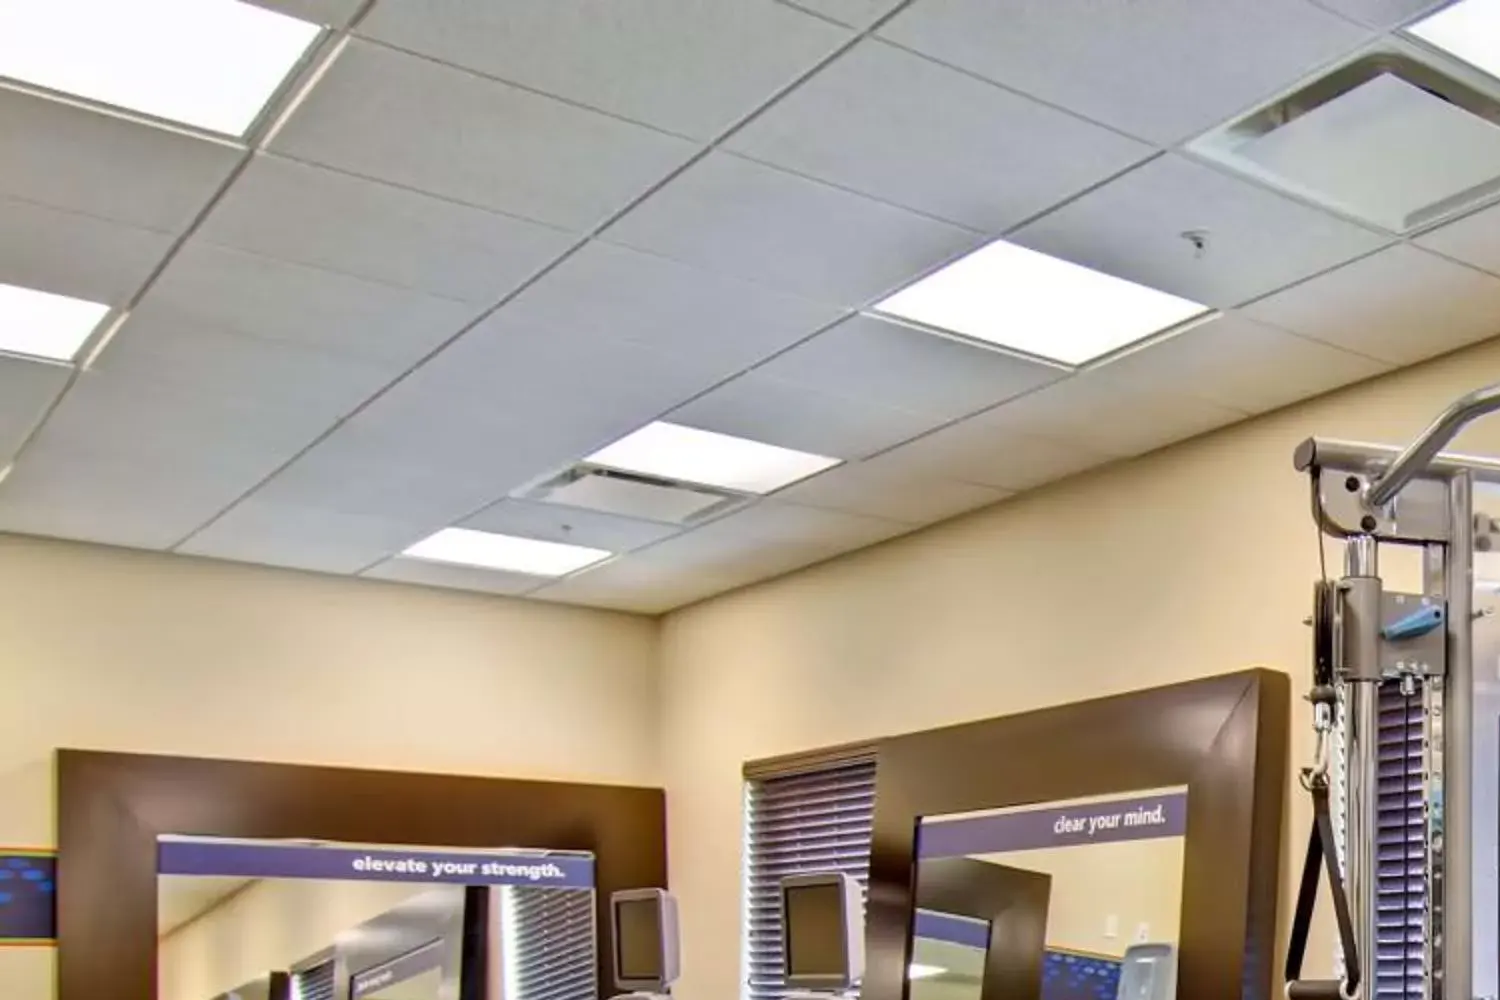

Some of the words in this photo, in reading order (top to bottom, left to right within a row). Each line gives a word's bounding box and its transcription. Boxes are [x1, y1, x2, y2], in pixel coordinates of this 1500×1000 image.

[1053, 815, 1087, 834] clear
[1088, 813, 1122, 835] your
[1124, 803, 1166, 826] mind.
[352, 855, 428, 873] elevate
[431, 860, 477, 877] your
[480, 860, 566, 880] strength.
